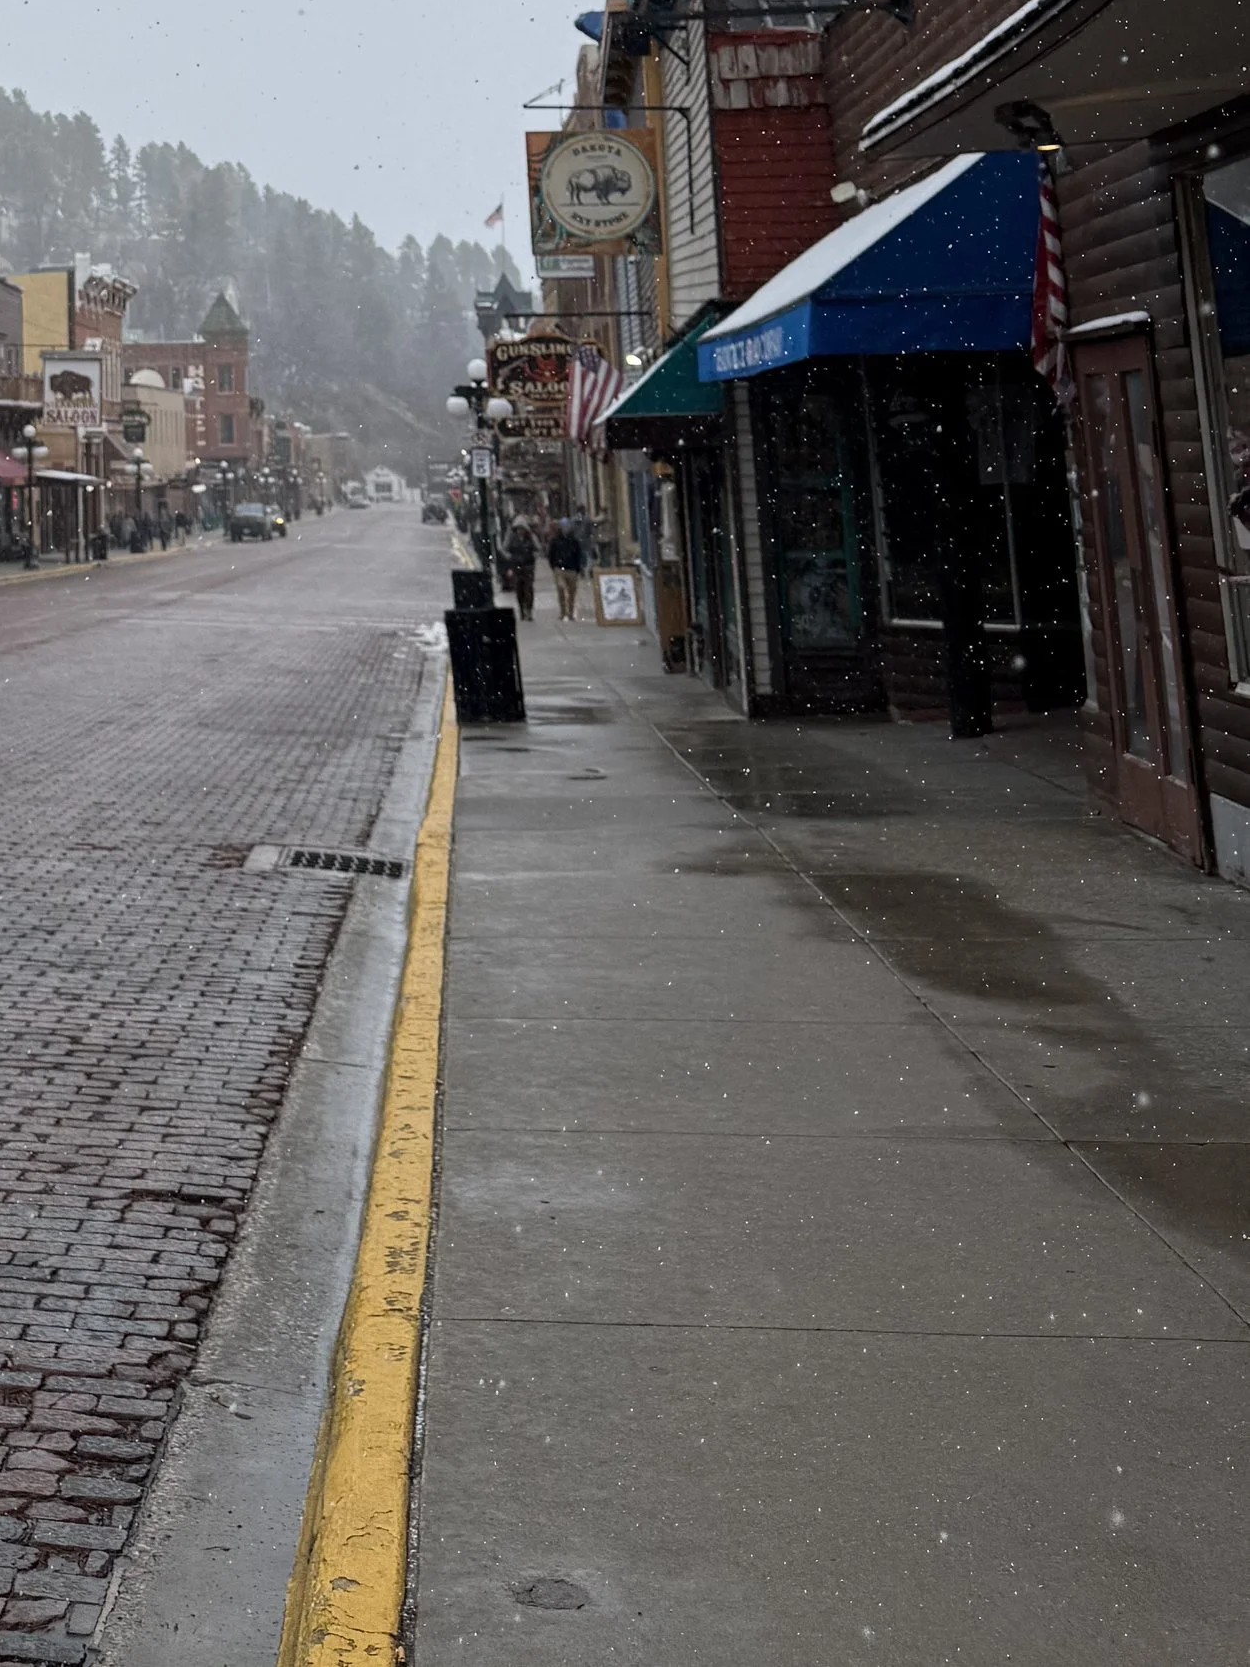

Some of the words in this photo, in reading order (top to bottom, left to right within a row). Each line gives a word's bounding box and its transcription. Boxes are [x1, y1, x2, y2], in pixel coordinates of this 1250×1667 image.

[572, 144, 622, 157] DAKOTA
[509, 380, 569, 395] SALOO
[47, 409, 98, 424] SALOON
